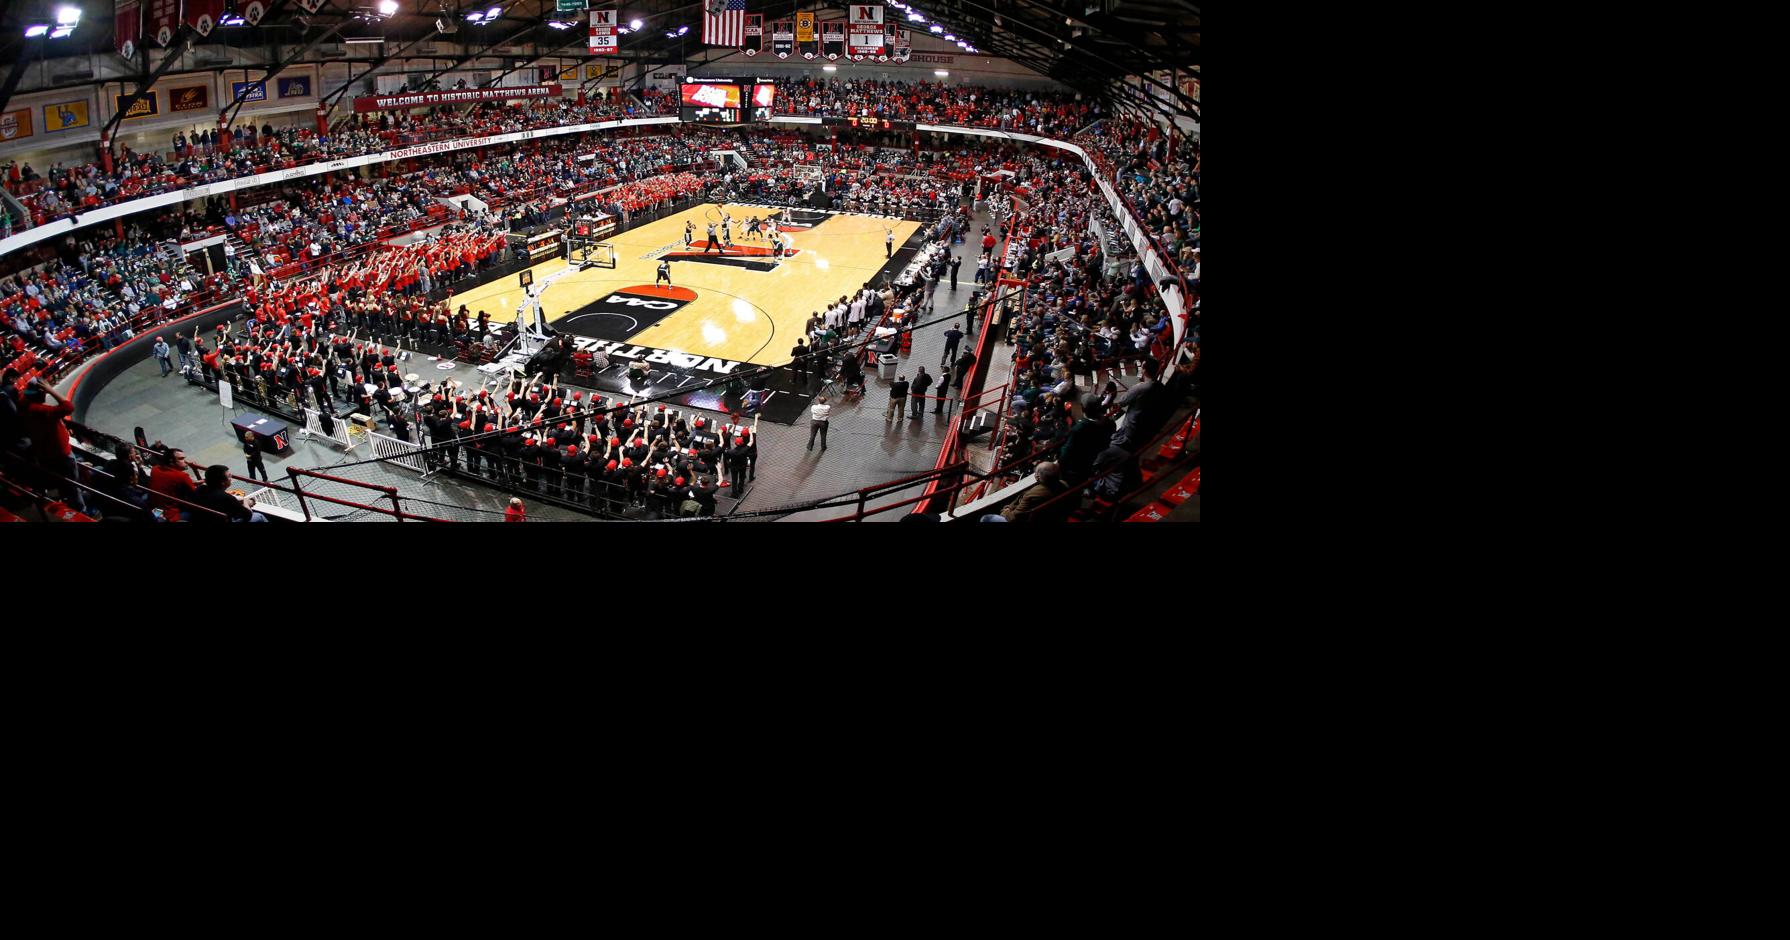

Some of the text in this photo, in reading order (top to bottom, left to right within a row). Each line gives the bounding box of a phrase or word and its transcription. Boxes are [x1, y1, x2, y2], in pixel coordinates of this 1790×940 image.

[597, 11, 609, 23] N
[859, 6, 874, 19] N
[598, 37, 609, 45] 35
[864, 35, 869, 44] 1
[376, 87, 550, 108] WELCOME TO HISTORIC MATTHEWS ARENA
[390, 137, 492, 159] NORTHEASTERN UNIVERSITY
[606, 295, 678, 310] CAA
[274, 430, 289, 450] N
